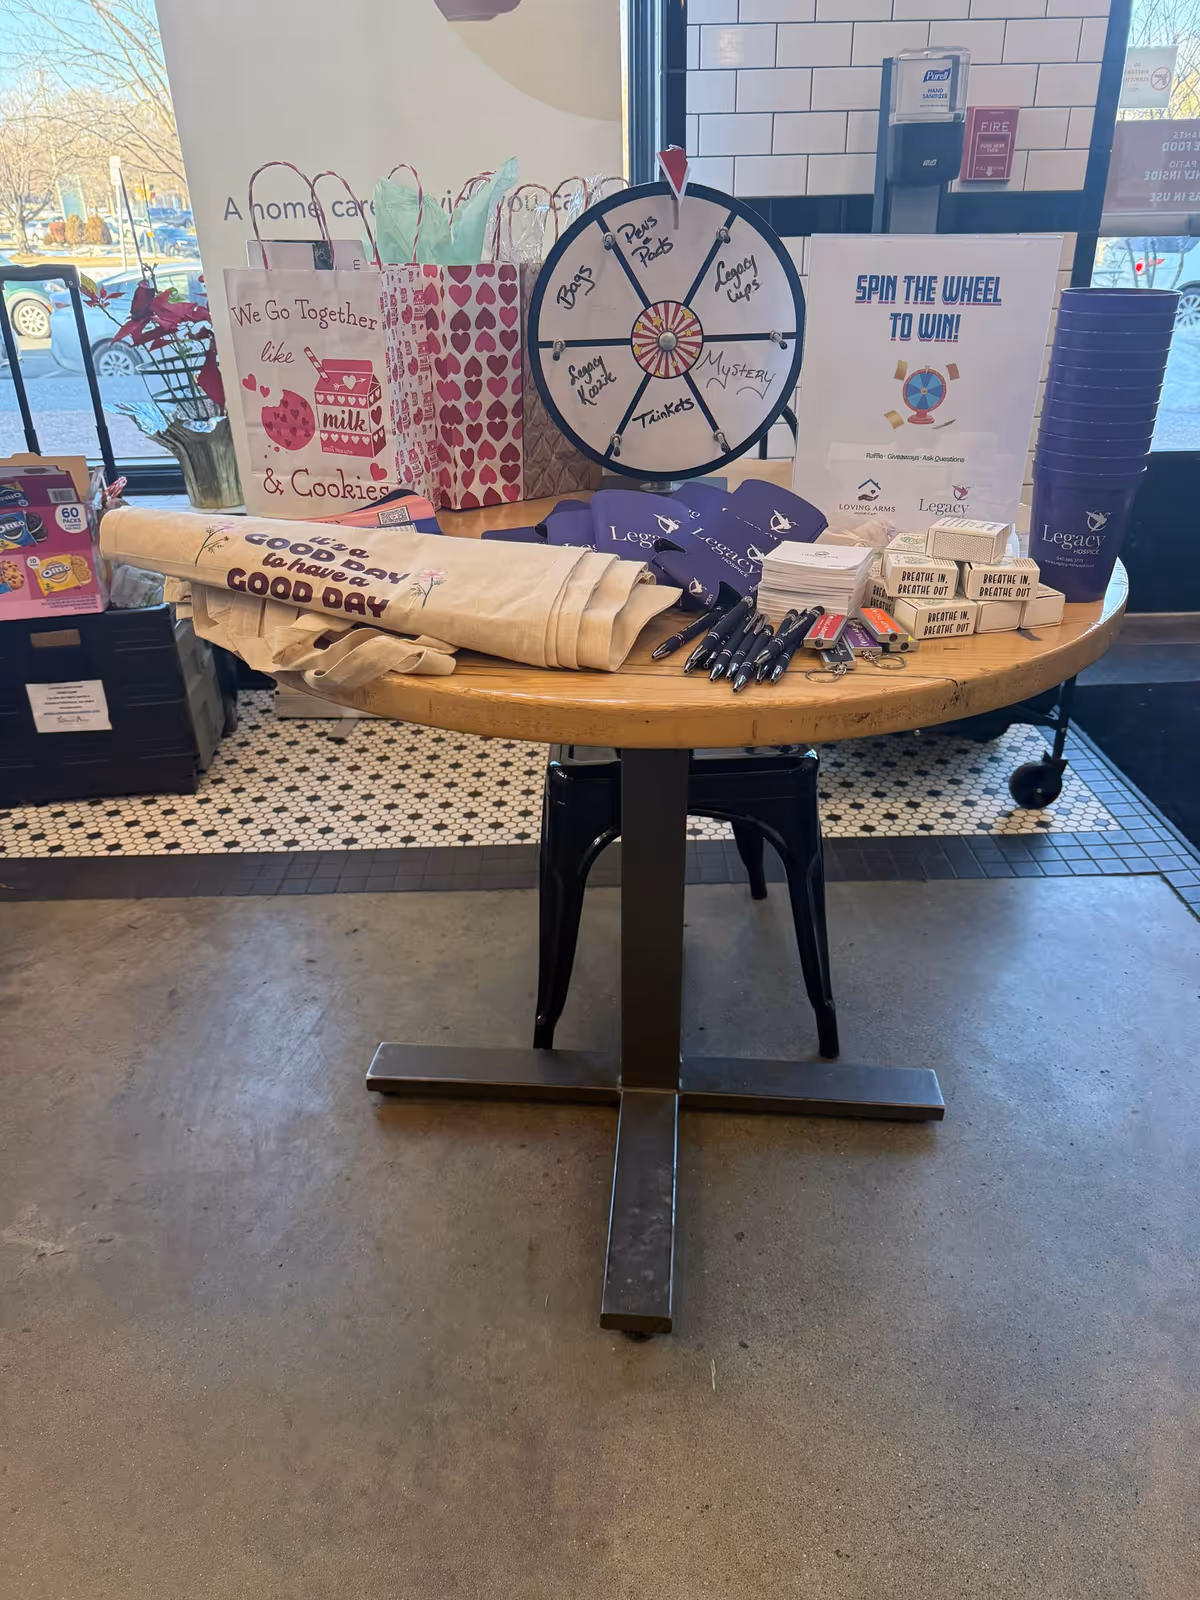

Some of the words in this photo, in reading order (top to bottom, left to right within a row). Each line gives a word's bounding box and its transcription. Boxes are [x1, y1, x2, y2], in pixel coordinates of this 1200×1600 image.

[926, 70, 950, 80] Purell
[980, 121, 1010, 132] FIRE
[223, 196, 244, 221] A
[714, 254, 759, 293] Legacy
[556, 264, 596, 310] Bags
[726, 277, 763, 303] Cups
[855, 274, 898, 304] SPIN
[903, 275, 938, 305] THE
[941, 275, 1002, 306] WHEEL
[231, 302, 262, 327] We
[264, 299, 290, 321] Go
[294, 298, 378, 331] Together
[889, 312, 914, 341] TO
[917, 312, 961, 342] WIN!
[260, 340, 296, 364] like
[568, 355, 609, 386] Legacy
[323, 408, 368, 432] milk
[887, 452, 920, 462] Giveaways
[934, 455, 966, 463] Questions
[263, 467, 285, 496] &
[291, 467, 390, 501] Cookies
[61, 507, 80, 518] 60
[838, 503, 871, 512] LOVING
[873, 505, 896, 513] ARMS
[918, 498, 970, 516] Legacy
[308, 535, 350, 551] it's
[348, 548, 371, 559] a
[609, 525, 660, 549] Leg
[1042, 523, 1107, 551] Legacy
[244, 533, 336, 563] GOOD
[340, 558, 411, 585] DAY
[690, 526, 762, 576] Legacy
[42, 564, 71, 579] OREO
[261, 552, 288, 568] to
[286, 557, 349, 582] have
[348, 575, 371, 588] a
[721, 555, 750, 579] HOSPICE
[901, 570, 935, 583] BREATHE
[937, 572, 949, 584] IN,
[897, 583, 930, 596] BREATHE
[933, 585, 949, 597] OUT
[982, 573, 1018, 585] BREATHE
[1019, 574, 1031, 586] IN,
[226, 567, 314, 604] GOOD
[321, 586, 390, 618] DAY
[703, 592, 714, 606] USA
[872, 585, 894, 602] BREA
[978, 586, 1012, 598] BREATHE
[1015, 587, 1031, 598] OUT
[927, 611, 958, 623] BREATHE
[959, 610, 970, 621] IN,
[923, 622, 954, 636] BREATHE
[955, 622, 971, 634] OUT
